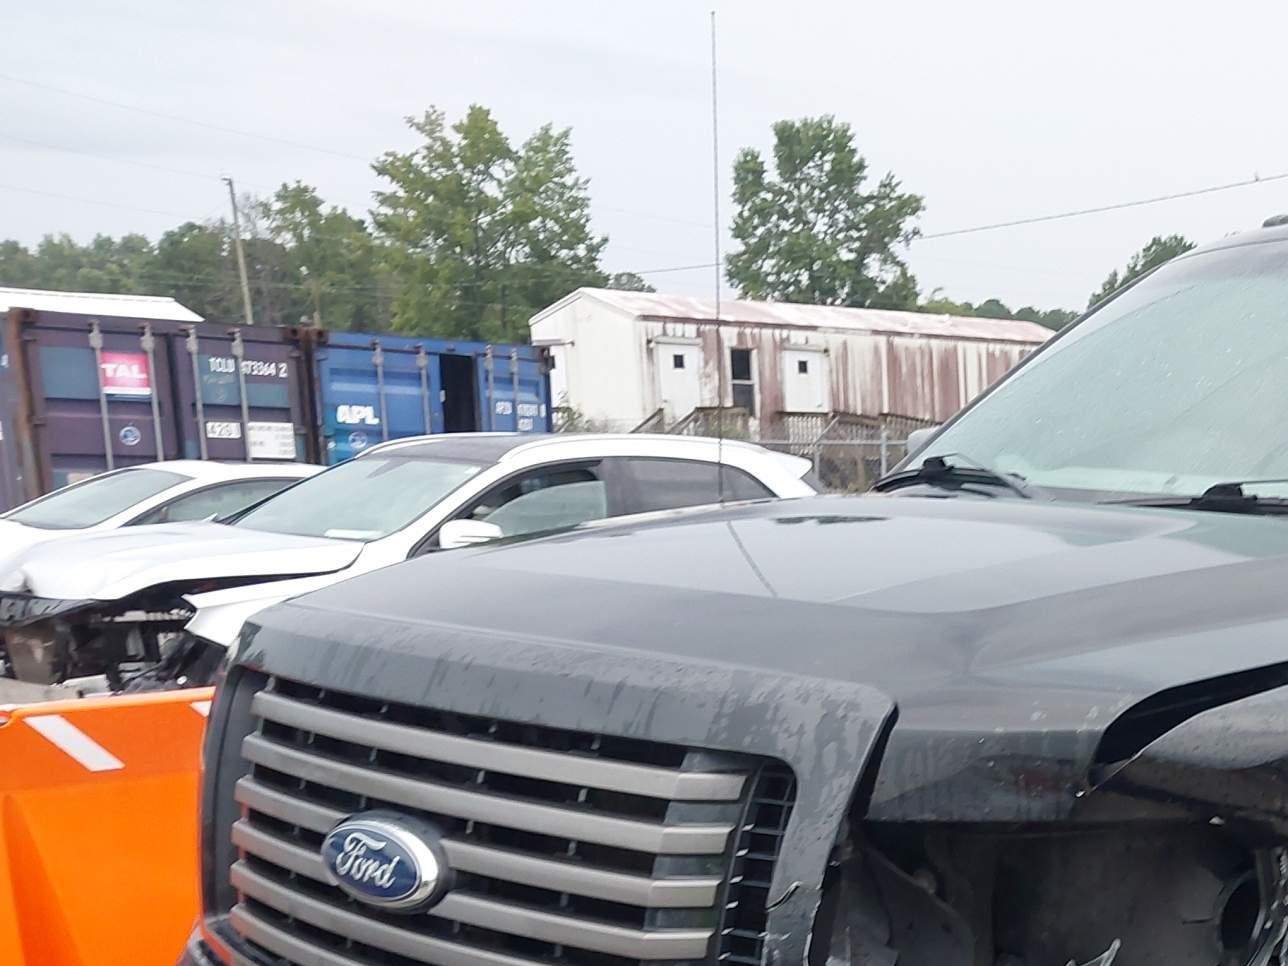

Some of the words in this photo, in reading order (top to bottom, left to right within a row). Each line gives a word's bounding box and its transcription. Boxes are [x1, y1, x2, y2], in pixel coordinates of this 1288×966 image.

[100, 363, 148, 379] TAL
[277, 362, 289, 378] 2
[336, 404, 380, 425] APL
[335, 831, 401, 889] Ford
